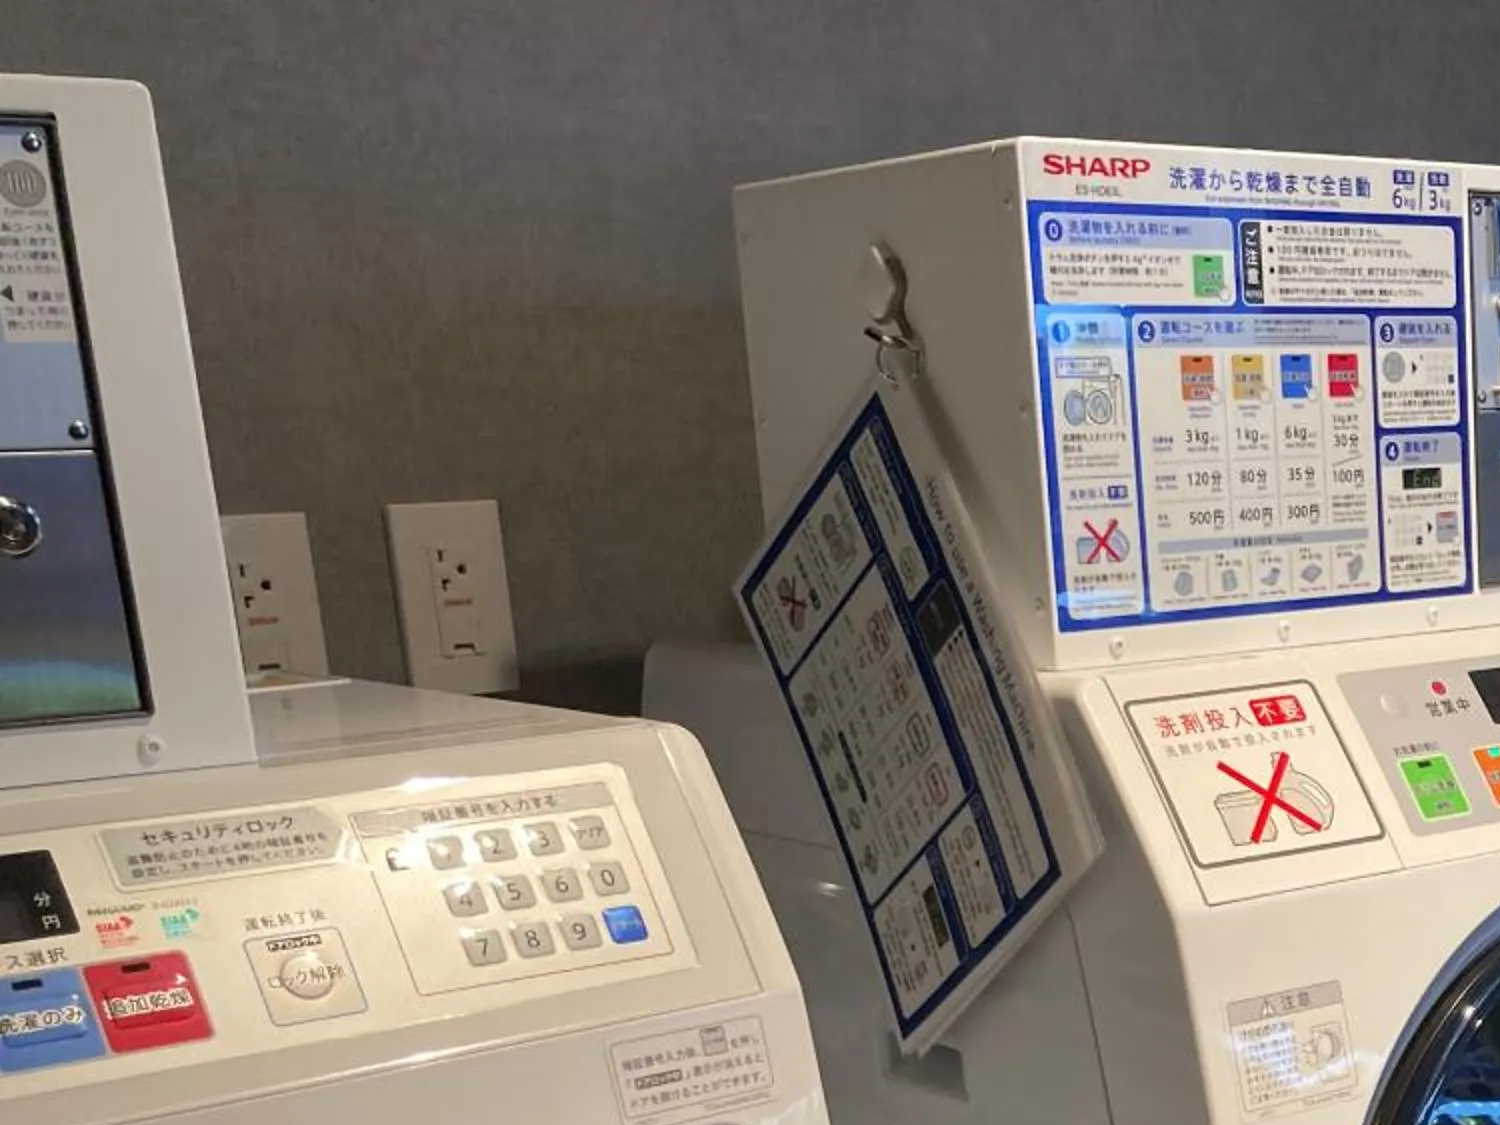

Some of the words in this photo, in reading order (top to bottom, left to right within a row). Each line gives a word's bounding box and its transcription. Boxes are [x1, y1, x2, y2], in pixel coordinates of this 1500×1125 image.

[1043, 154, 1151, 178] SHARP
[1169, 166, 1371, 197] 洗濯から乾燥まで全自動
[1160, 320, 1245, 335] 運転コースを選ぶ
[1334, 434, 1359, 448] 30分
[1188, 470, 1222, 487] 120分
[1240, 469, 1267, 484] 80分
[1287, 467, 1315, 482] 35分
[1333, 469, 1365, 484] 100円
[1189, 509, 1224, 526] 500円
[1239, 508, 1273, 521] 400円
[1287, 505, 1320, 520] 300円
[972, 592, 1009, 676] Washing
[1154, 707, 1252, 739] 洗剤投入
[1253, 697, 1305, 725] 不要
[1164, 726, 1317, 758] 洗剤が自動で投入されます
[421, 794, 559, 824] 暗証番号を入力する
[142, 815, 294, 847] セキュリティロック
[537, 831, 550, 849] 3
[489, 839, 502, 857] 2
[556, 877, 570, 895] 6
[602, 870, 616, 888] 0
[33, 891, 51, 907] 分
[507, 883, 521, 901] 5
[42, 915, 61, 930] 円
[526, 930, 541, 949] 8
[573, 923, 588, 942] 9
[476, 937, 490, 957] 7
[107, 988, 192, 1019] 追加乾燥
